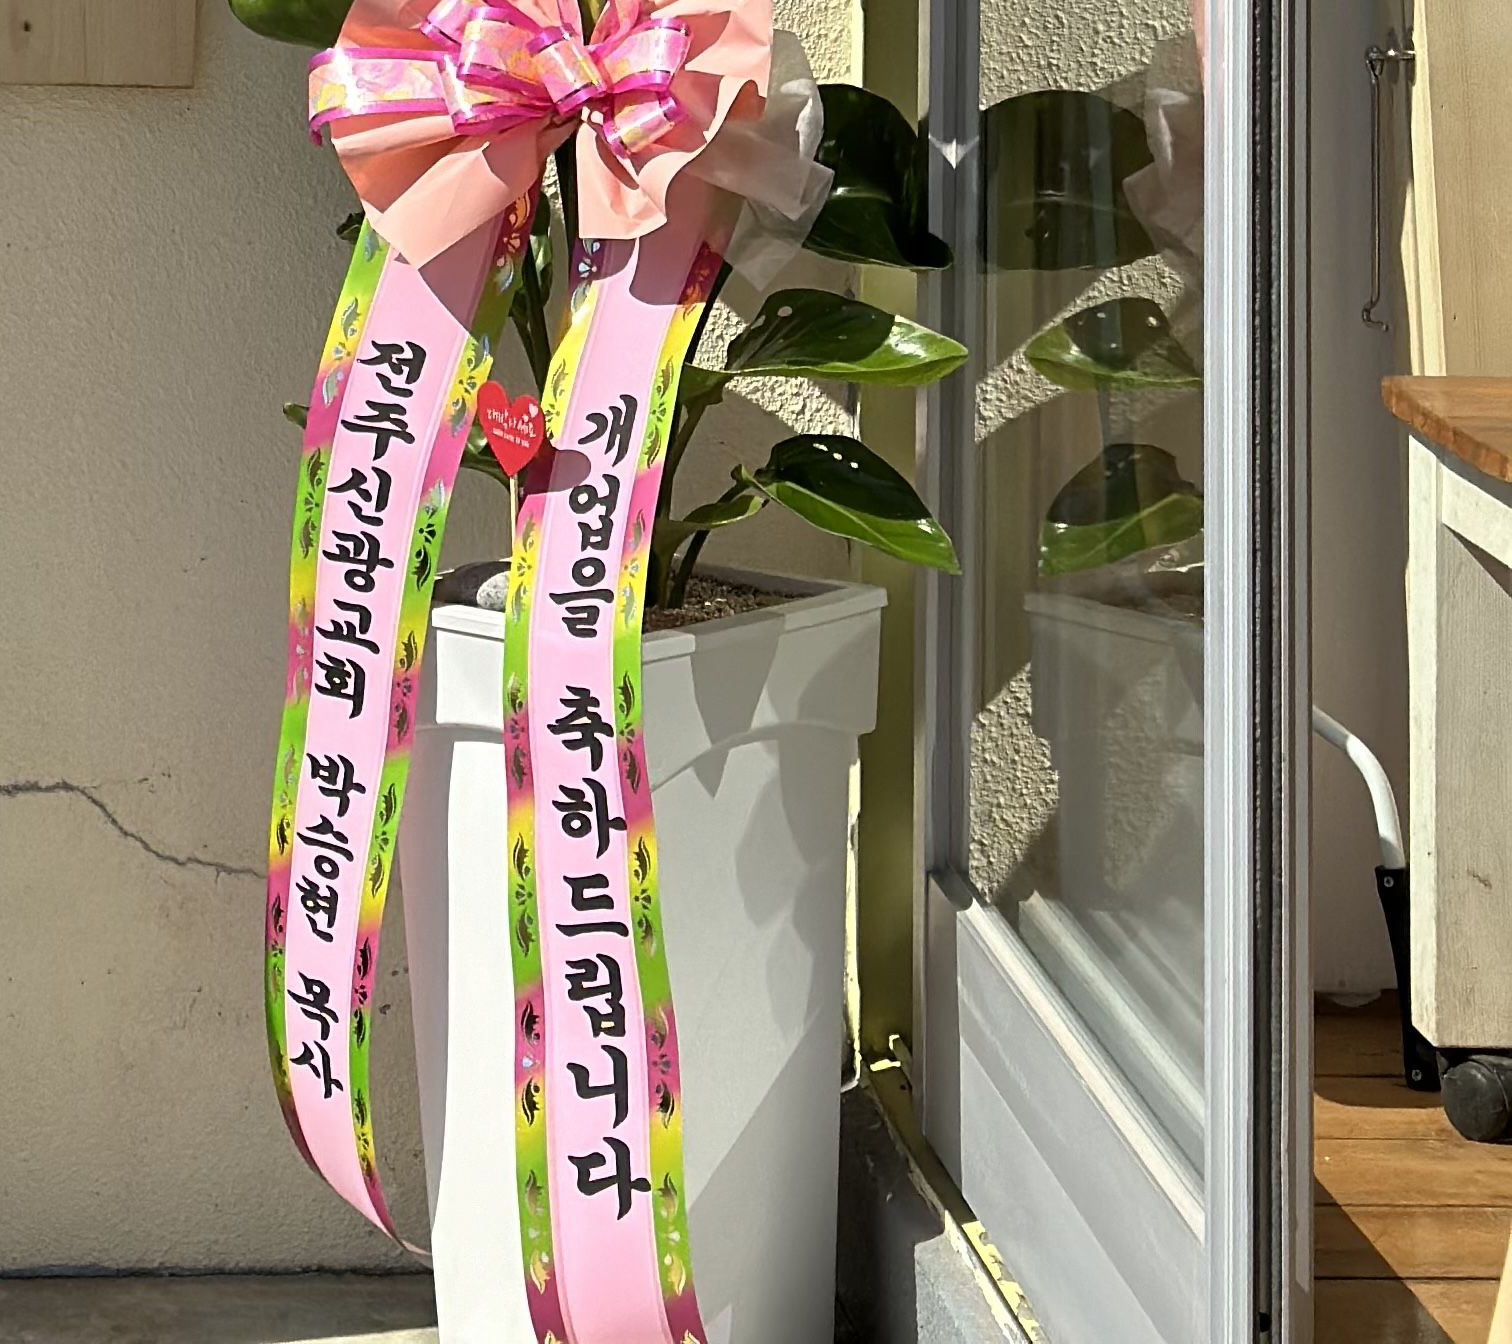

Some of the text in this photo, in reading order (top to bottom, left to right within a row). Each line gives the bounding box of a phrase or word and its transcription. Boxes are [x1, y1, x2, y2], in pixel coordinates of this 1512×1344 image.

[287, 339, 427, 1100] 전주신광교회 박승현 목사
[546, 394, 653, 1221] 개업을 축하드립니다
